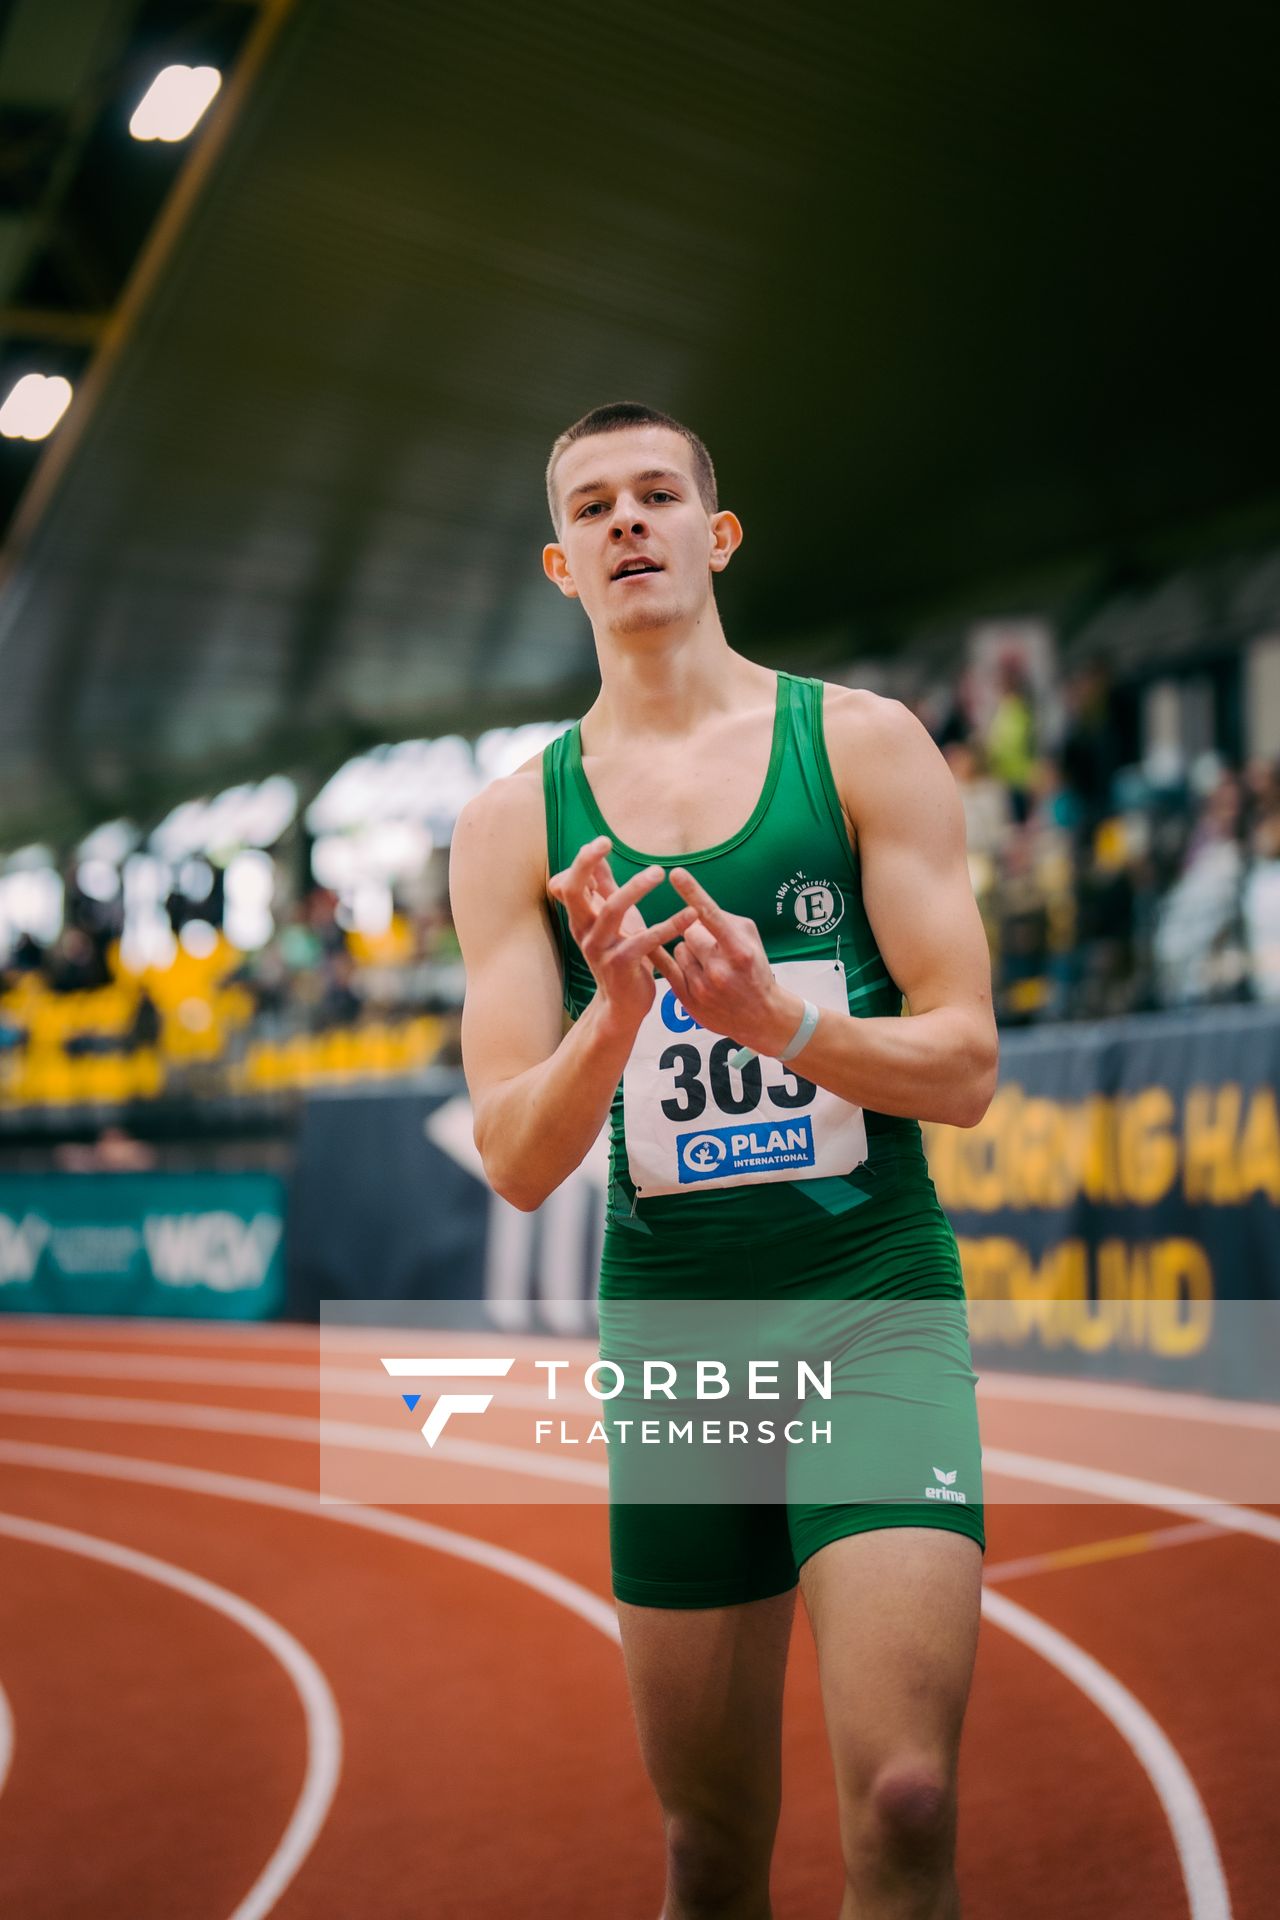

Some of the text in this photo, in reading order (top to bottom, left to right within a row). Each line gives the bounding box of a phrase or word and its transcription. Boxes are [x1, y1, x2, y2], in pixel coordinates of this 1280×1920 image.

[775, 882, 791, 900] 1861
[793, 879, 830, 893] Eintracht
[801, 891, 827, 923] E
[796, 917, 836, 934] Hildesheim
[731, 1127, 807, 1157] PLAN
[733, 1153, 809, 1168] INTERNATIONAL
[925, 1486, 966, 1504] erima
